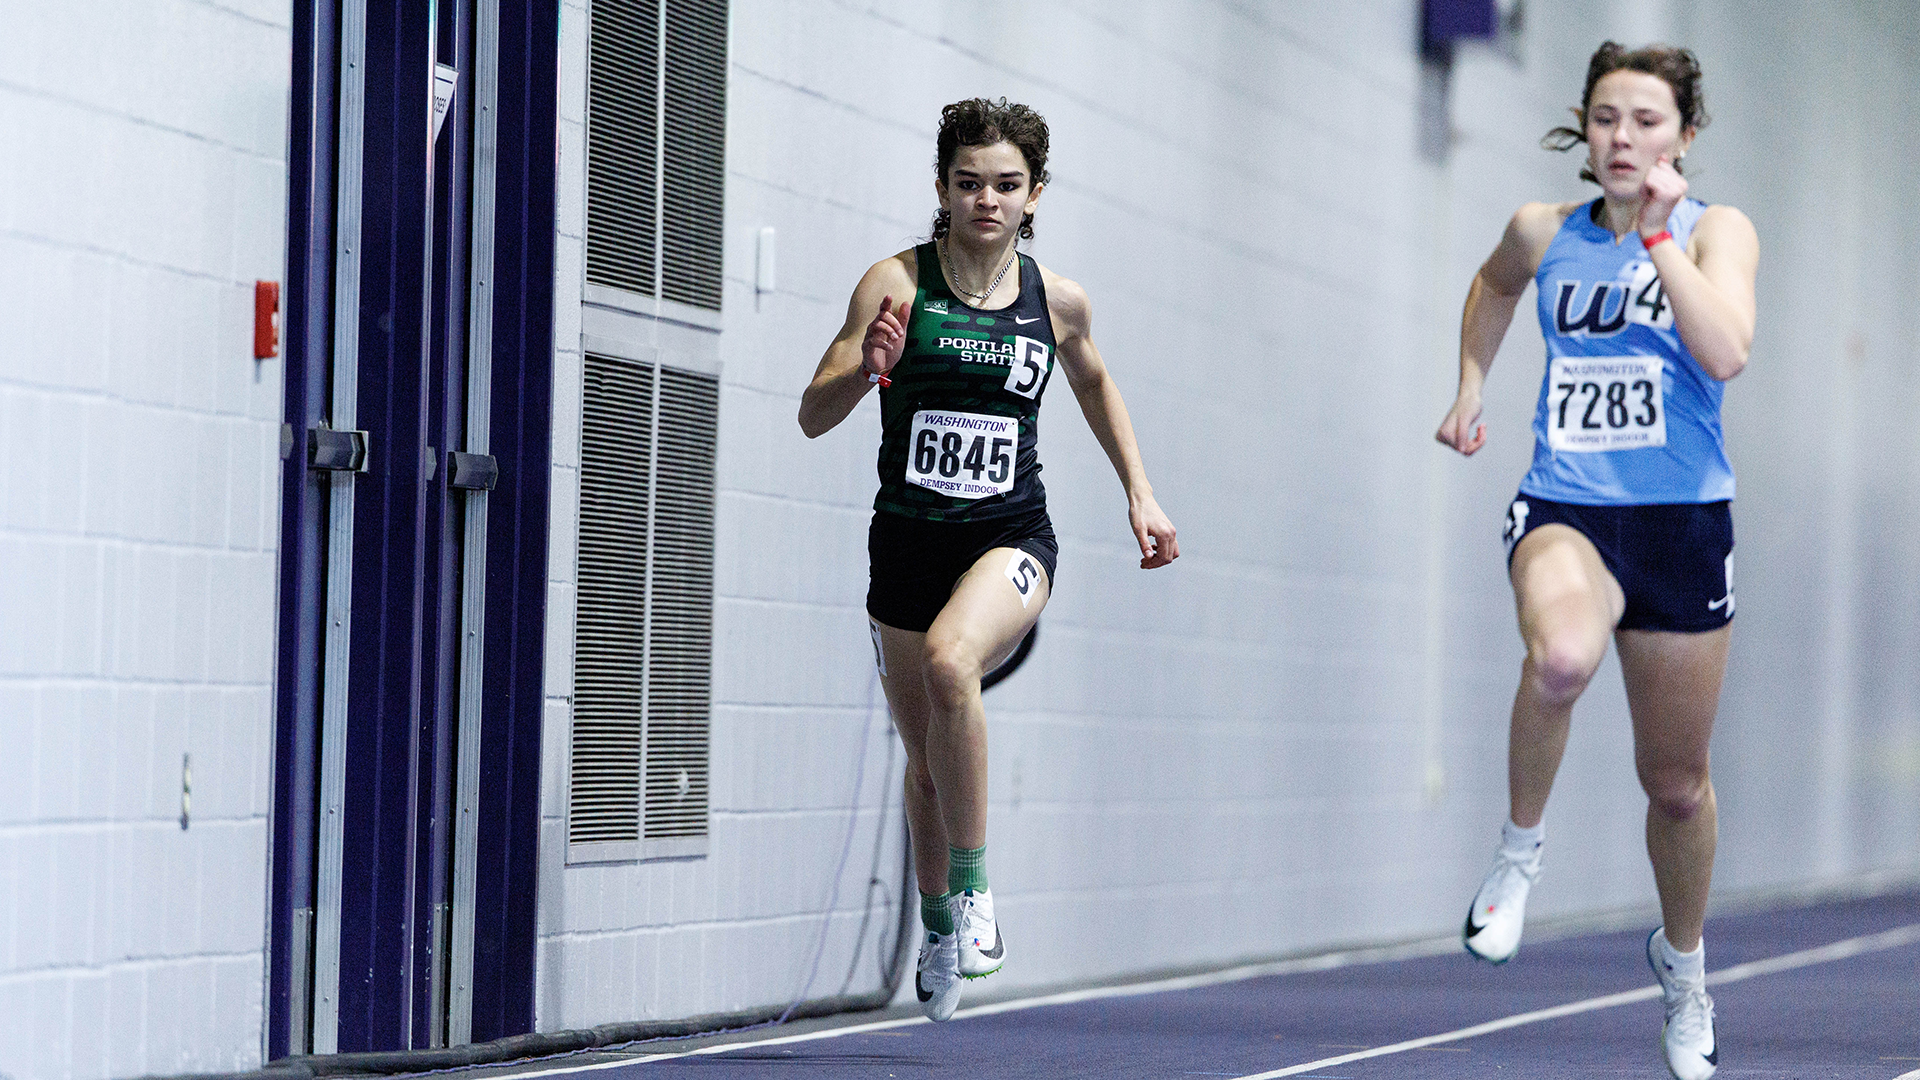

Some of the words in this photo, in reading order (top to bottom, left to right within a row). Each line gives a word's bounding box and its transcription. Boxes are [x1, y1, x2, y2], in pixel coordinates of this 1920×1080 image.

[1636, 276, 1666, 321] 4
[938, 337, 1016, 355] PORTLA
[1015, 341, 1043, 393] 5
[924, 414, 1008, 433] WASHINGTON
[1557, 379, 1657, 429] 7283
[914, 429, 1013, 484] 6845
[920, 478, 962, 491] DEMPSEY
[964, 484, 999, 495] INDOOR
[1012, 558, 1038, 595] 5
